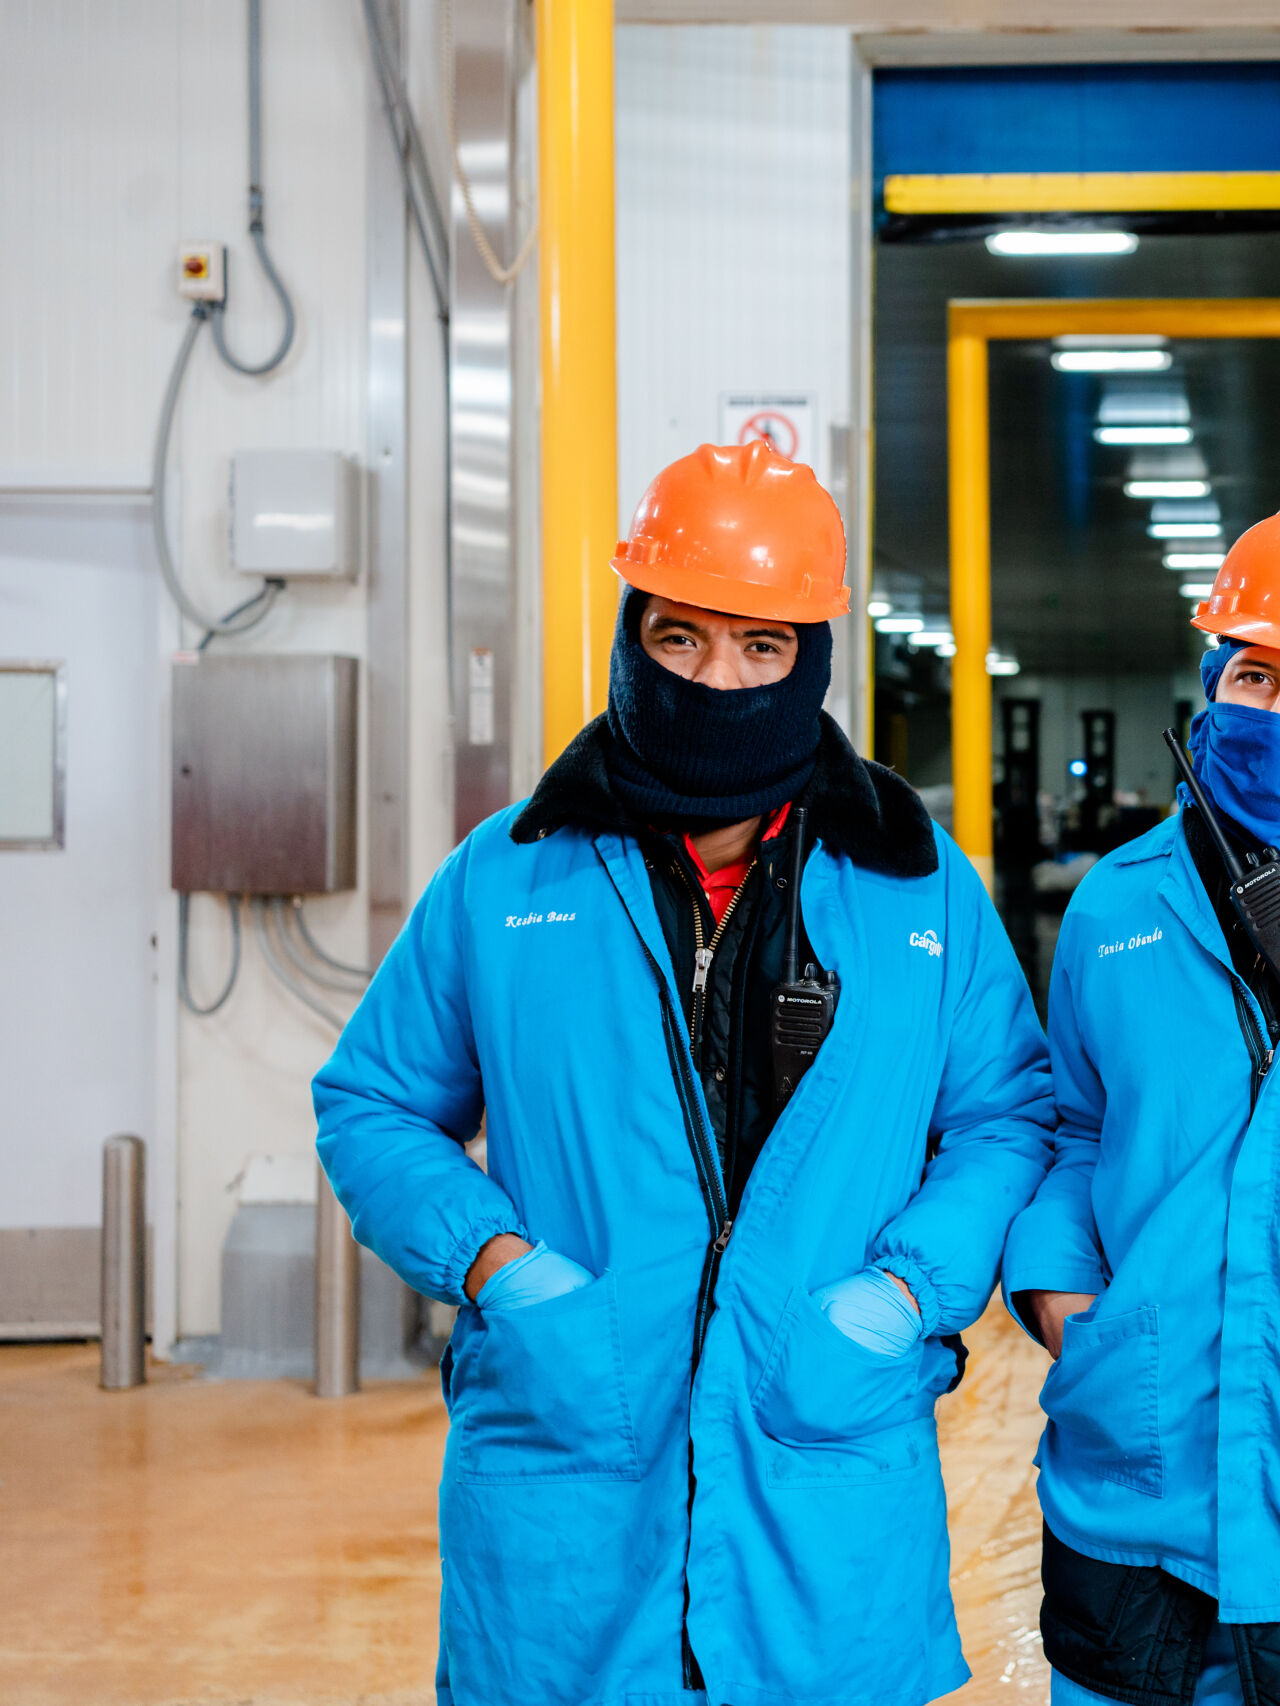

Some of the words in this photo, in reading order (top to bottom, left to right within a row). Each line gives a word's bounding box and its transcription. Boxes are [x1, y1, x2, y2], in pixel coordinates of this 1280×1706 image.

[1244, 867, 1276, 889] MOTOROLA
[1098, 941, 1125, 958] Tania
[1128, 926, 1163, 950] Obando
[786, 997, 822, 1005] MOTOROLA
